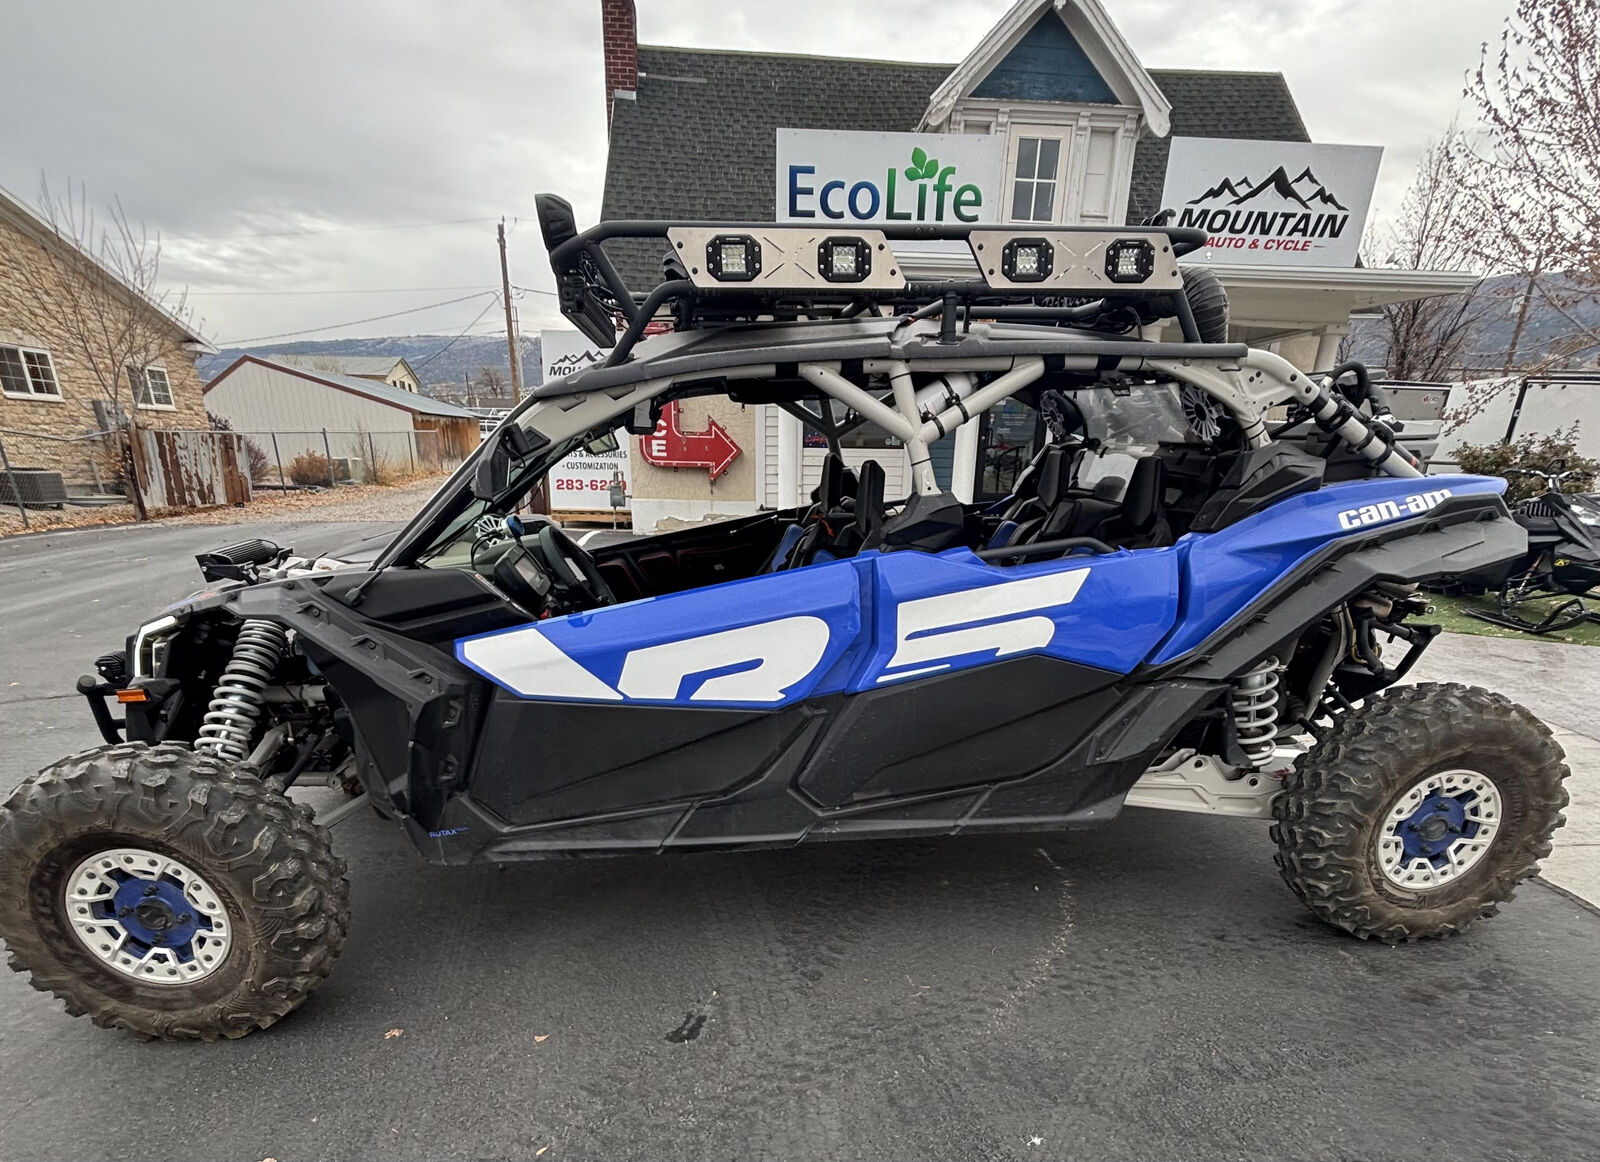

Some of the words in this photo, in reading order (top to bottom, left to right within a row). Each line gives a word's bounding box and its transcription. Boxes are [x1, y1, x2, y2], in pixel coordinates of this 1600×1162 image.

[788, 164, 983, 223] EcoLife
[1177, 207, 1350, 239] MOUNTAIN
[1204, 236, 1246, 250] AUTO
[1248, 238, 1259, 249] &
[1263, 238, 1313, 252] CYCLE
[566, 461, 619, 471] CUSTOMIZATION
[1337, 488, 1453, 530] can-am
